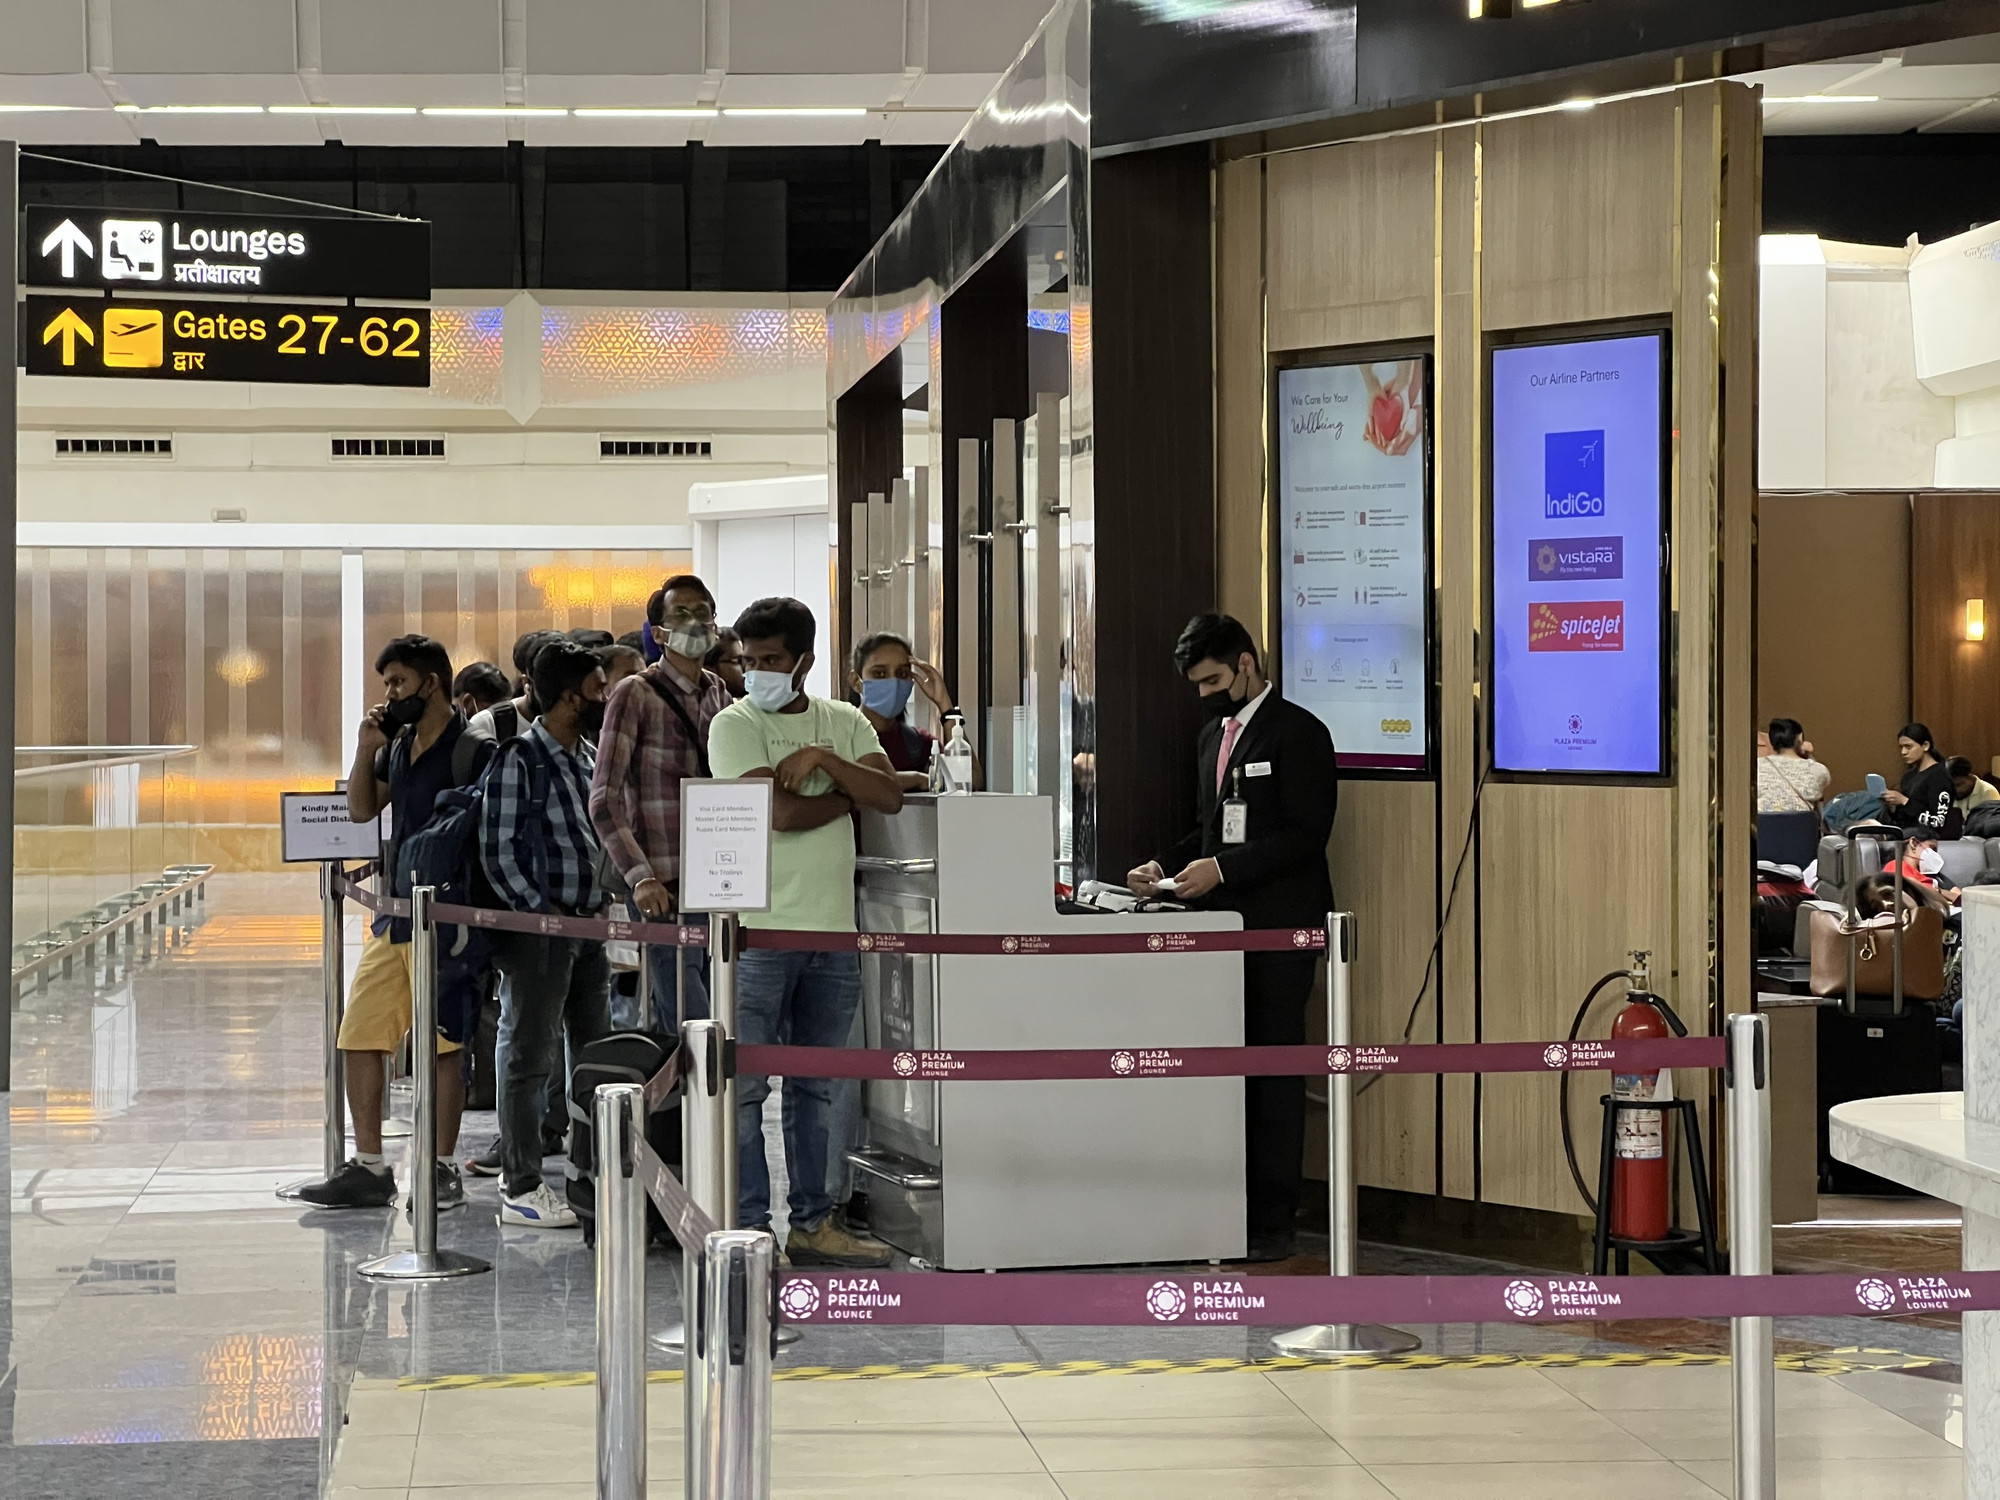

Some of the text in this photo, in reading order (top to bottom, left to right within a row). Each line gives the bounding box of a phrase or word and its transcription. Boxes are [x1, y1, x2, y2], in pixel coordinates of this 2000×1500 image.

[172, 222, 306, 260] Lounges
[173, 259, 261, 286] प्रतीक्षालय
[173, 310, 421, 358] Gates 27-62
[173, 350, 205, 372] द्वार
[1530, 369, 1620, 386] Our Airline Partners
[1291, 393, 1348, 406] We Care for Your
[1546, 491, 1603, 516] IndiGo
[302, 804, 329, 812] Kindly
[1356, 1047, 1386, 1055] PLAZA
[1572, 1042, 1603, 1051] PLAZA
[922, 1052, 952, 1060] PLAZA
[1139, 1050, 1170, 1059] PLAZA
[1356, 1056, 1399, 1064] PREMIUM
[1572, 1051, 1616, 1060] PREMIUM
[922, 1061, 965, 1070] PREMIUM
[1139, 1059, 1182, 1067] PREMIUM
[828, 1279, 880, 1292] PLAZA
[1193, 1281, 1244, 1294] PLAZA
[1548, 1280, 1599, 1292] PLAZA
[1898, 1276, 1948, 1290] PLAZA
[828, 1293, 900, 1307] PREMIUM
[1550, 1293, 1622, 1306] PREMIUM
[1902, 1288, 1972, 1300] PREMIUM
[1193, 1296, 1265, 1309] PREMIUM
[1906, 1300, 1950, 1310] LOUNGE
[828, 1310, 873, 1319] LOUNGE
[1194, 1312, 1239, 1320] LOUNGE
[1554, 1307, 1597, 1316] LOUNGE
